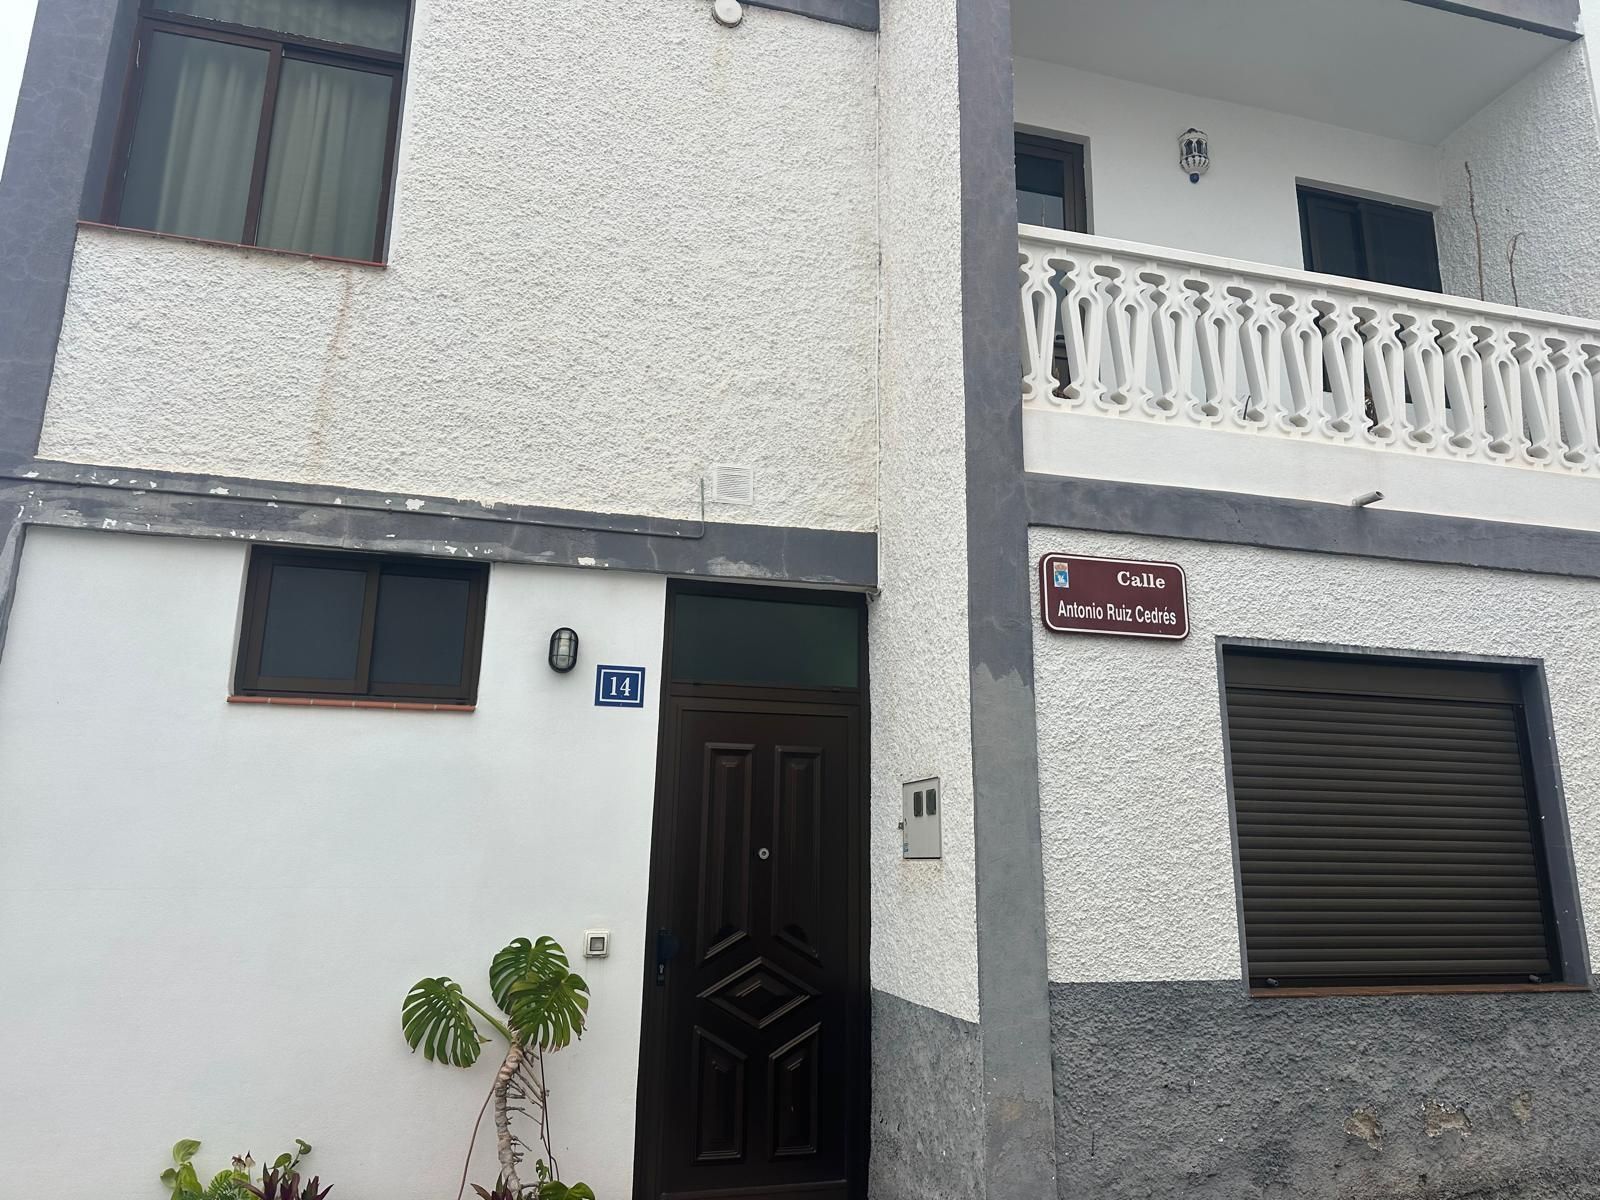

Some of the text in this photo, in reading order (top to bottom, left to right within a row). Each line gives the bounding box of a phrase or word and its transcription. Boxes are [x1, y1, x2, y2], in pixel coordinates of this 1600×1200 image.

[1117, 571, 1166, 588] Calle
[1058, 600, 1177, 625] Antonio Ruiz Cedrés
[610, 676, 631, 696] 14
